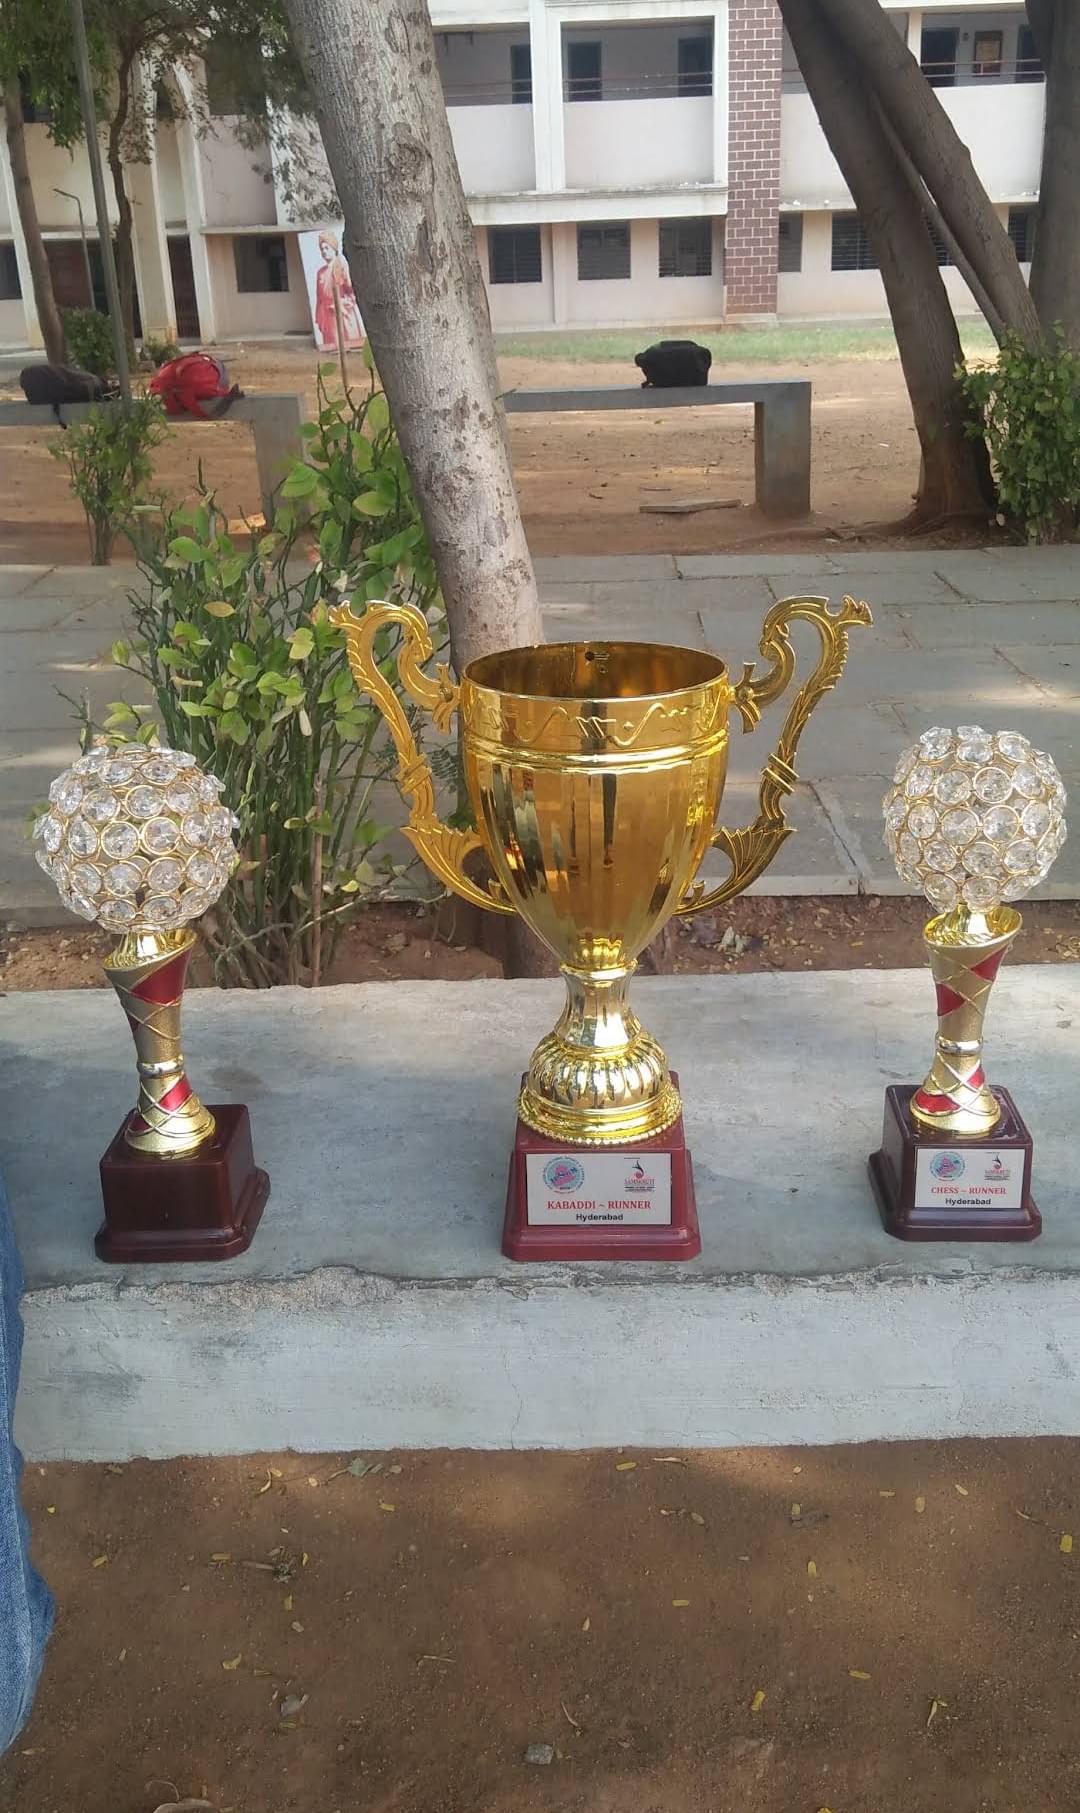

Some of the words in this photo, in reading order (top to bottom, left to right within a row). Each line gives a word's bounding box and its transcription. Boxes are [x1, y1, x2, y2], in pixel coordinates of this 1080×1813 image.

[969, 1187, 1006, 1195] RUNNER
[547, 1200, 596, 1210] KABADDI
[607, 1200, 651, 1210] RUNNER
[945, 1198, 991, 1206] Hyderabad
[576, 1213, 624, 1222] Hyderabad
